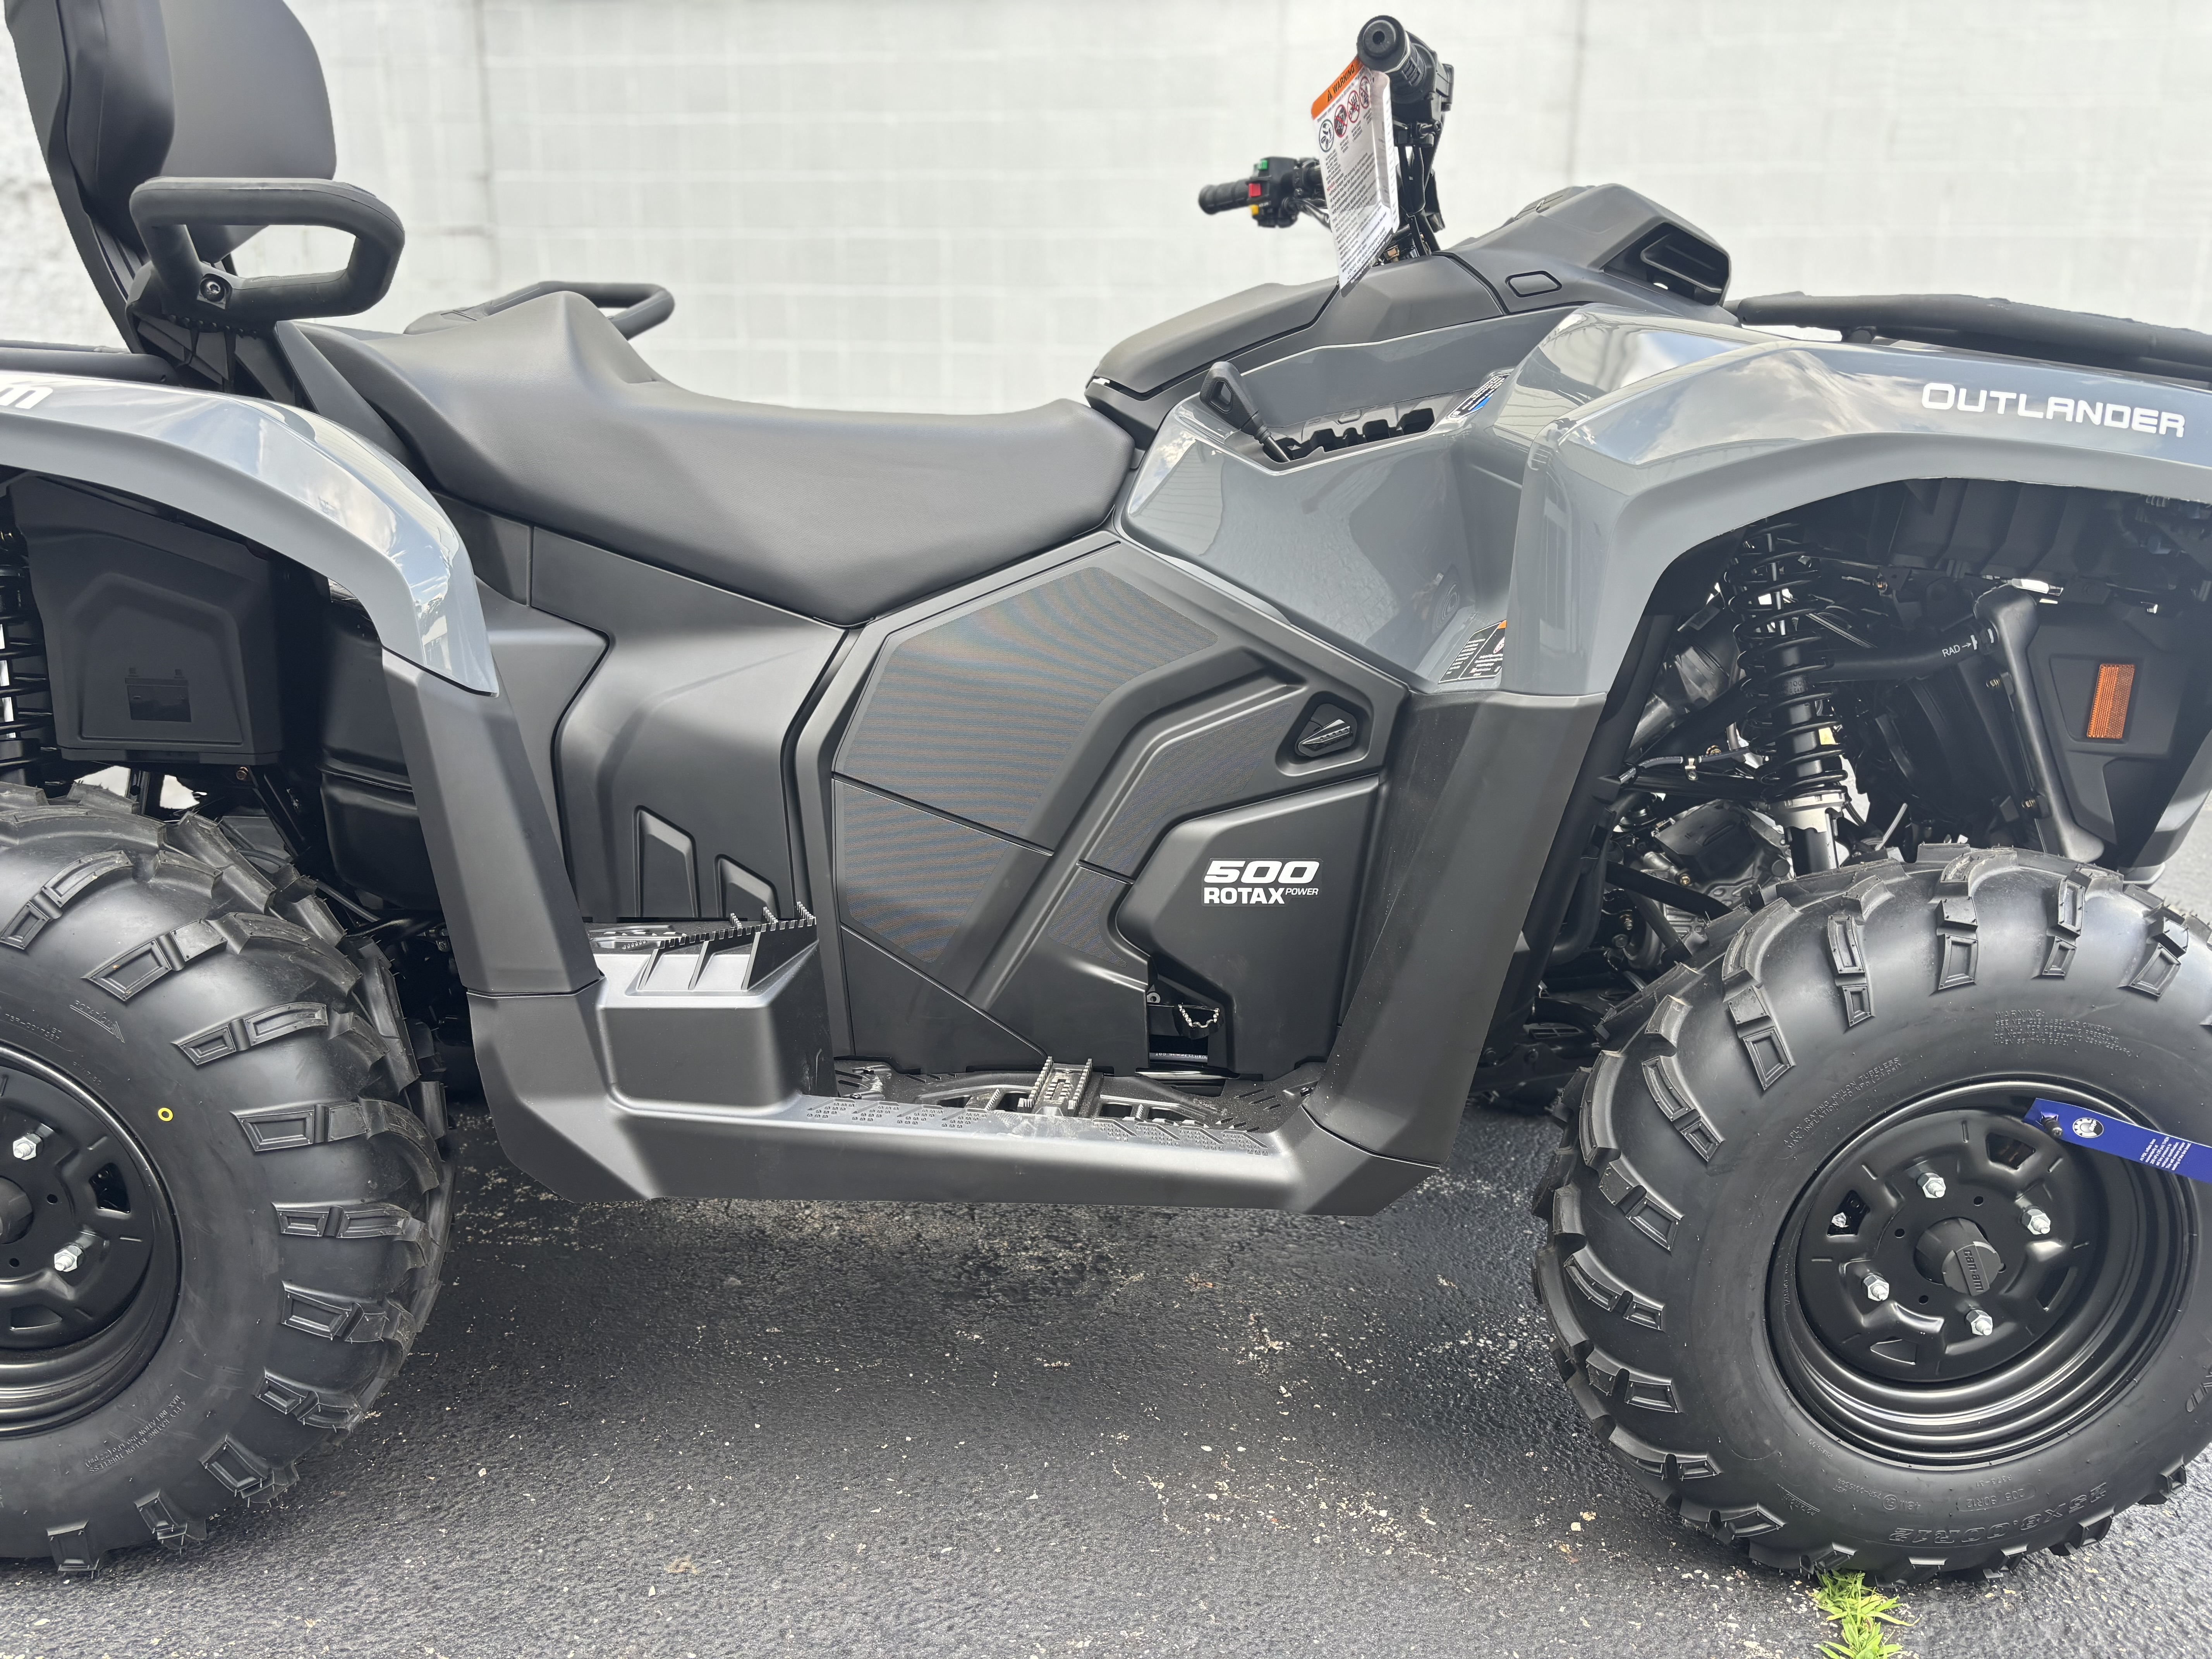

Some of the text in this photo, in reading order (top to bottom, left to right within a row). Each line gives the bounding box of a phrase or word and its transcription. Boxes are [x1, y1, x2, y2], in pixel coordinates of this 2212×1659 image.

[1332, 64, 1355, 94] WARNING
[1921, 382, 2185, 438] OUTLANDER
[1941, 644, 1961, 658] RAD
[1204, 860, 1320, 884] 500
[1204, 887, 1319, 904] ROTAX POWER
[1789, 1124, 1803, 1138] PLY
[1804, 1100, 1830, 1123] RATING
[1831, 1080, 1857, 1101] NYLON
[1858, 1057, 1900, 1082] TUBELESS
[1803, 1101, 1839, 1133] INFLATION
[1963, 1249, 1984, 1293] can-am
[137, 1409, 168, 1437] INFLATION
[147, 1418, 170, 1439] RATING
[88, 1452, 124, 1474] TUBELESS
[1888, 1481, 2107, 1544] 25X8.00R12
